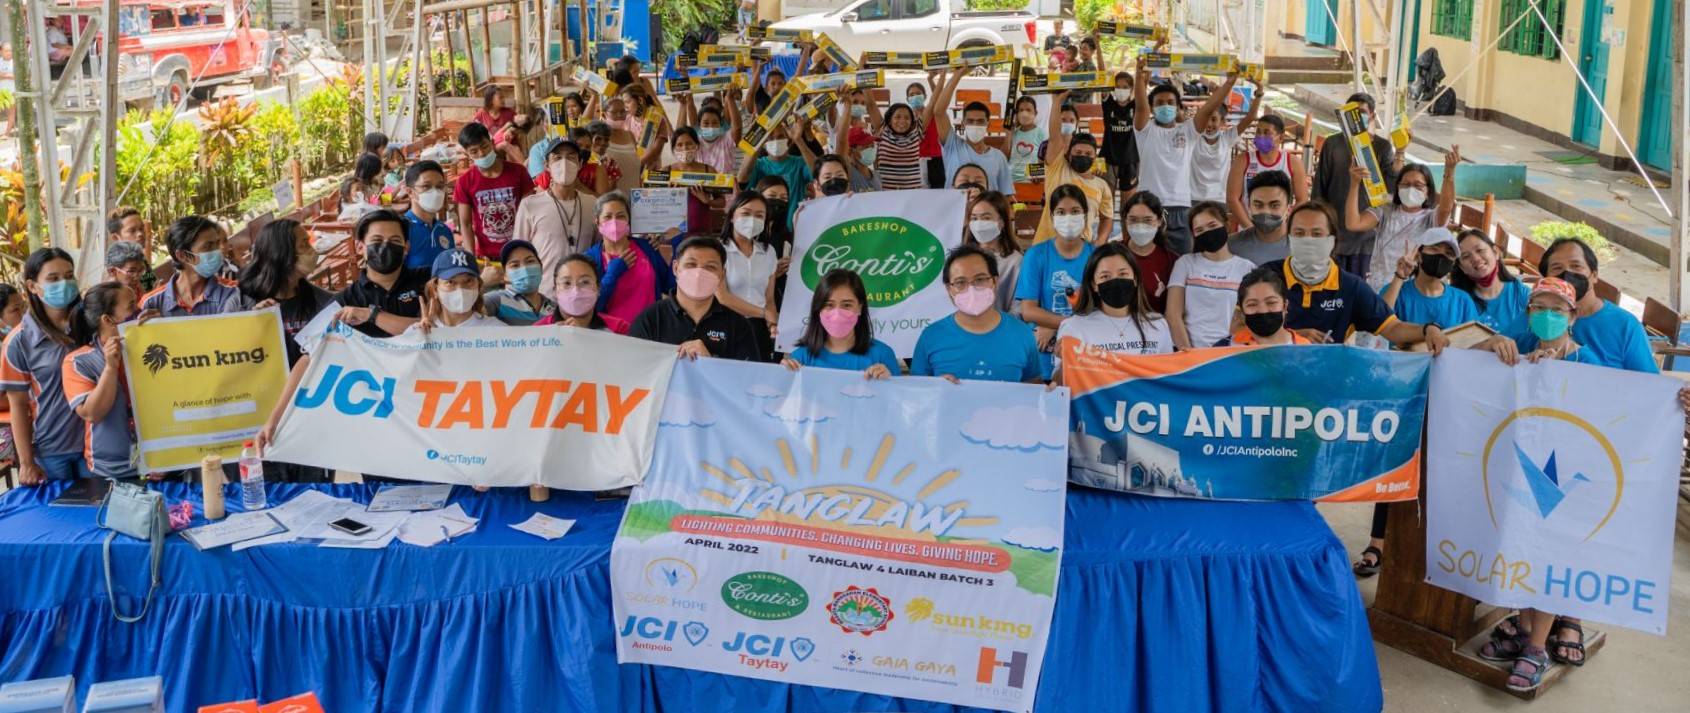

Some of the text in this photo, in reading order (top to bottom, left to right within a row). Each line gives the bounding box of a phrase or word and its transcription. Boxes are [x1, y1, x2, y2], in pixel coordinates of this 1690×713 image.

[842, 222, 907, 236] BAKESHOP
[812, 243, 935, 277] Conti's
[866, 284, 916, 302] AURANT
[1320, 300, 1335, 308] JCI
[890, 318, 931, 334] yours
[445, 340, 454, 348] is
[456, 340, 473, 348] the
[476, 339, 498, 348] Best
[501, 339, 526, 348] Work
[530, 338, 539, 347] of
[542, 338, 563, 347] Life.
[1127, 340, 1159, 349] PRESENT
[171, 353, 211, 370] sun
[294, 364, 650, 435] JCI TAYTAY
[1104, 400, 1400, 443] JCI ANTIPOLO
[729, 477, 967, 537] TANGLAW
[681, 519, 998, 566] LIGHTING COMMUNITIES. CHANGING LIVES. GIVING HOPE.
[684, 537, 759, 554] APRIL 2022
[808, 554, 994, 586] TANGLAW 4 LAIBAN BATCH 3
[1437, 540, 1656, 614] SOLAR HOPE
[728, 581, 803, 607] Conti's
[671, 598, 708, 611] HOPE
[619, 615, 678, 641] JCI
[932, 612, 975, 629] sun
[632, 641, 672, 652] Antipolo
[721, 631, 786, 658] JCI
[738, 653, 789, 673] Taytay
[872, 655, 958, 677] GAIA GAYA
